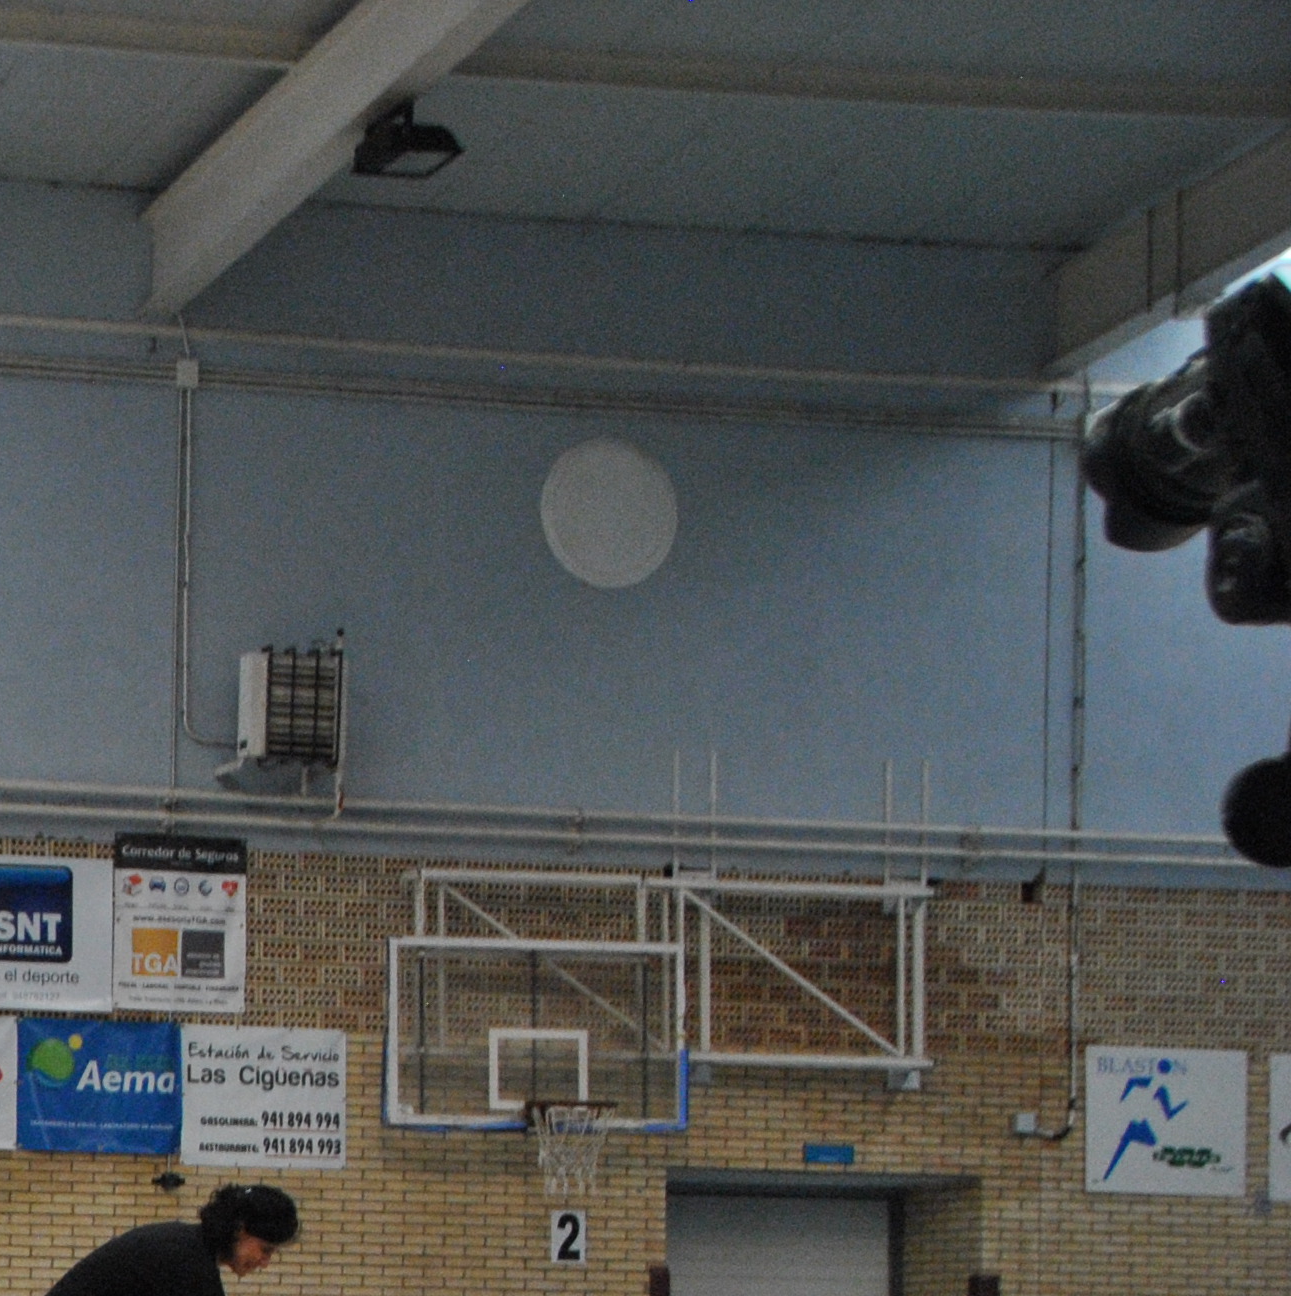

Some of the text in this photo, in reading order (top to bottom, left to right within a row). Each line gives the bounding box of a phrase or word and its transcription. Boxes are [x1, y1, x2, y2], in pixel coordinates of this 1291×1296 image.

[122, 843, 175, 858] Corredor
[178, 847, 192, 858] de
[195, 848, 239, 864] Seguros
[132, 953, 179, 973] TGA
[4, 967, 18, 982] el
[22, 968, 80, 986] deporte
[188, 1041, 340, 1063] Estación de Servicio
[76, 1059, 175, 1094] Aema
[187, 1063, 340, 1092] Las Cigüeñas
[261, 1110, 284, 1128] 941
[287, 1111, 312, 1129] 894
[316, 1112, 341, 1131] 994
[263, 1137, 285, 1155] 941
[289, 1138, 313, 1156] 894
[318, 1139, 342, 1156] 993
[557, 1212, 581, 1261] 2
